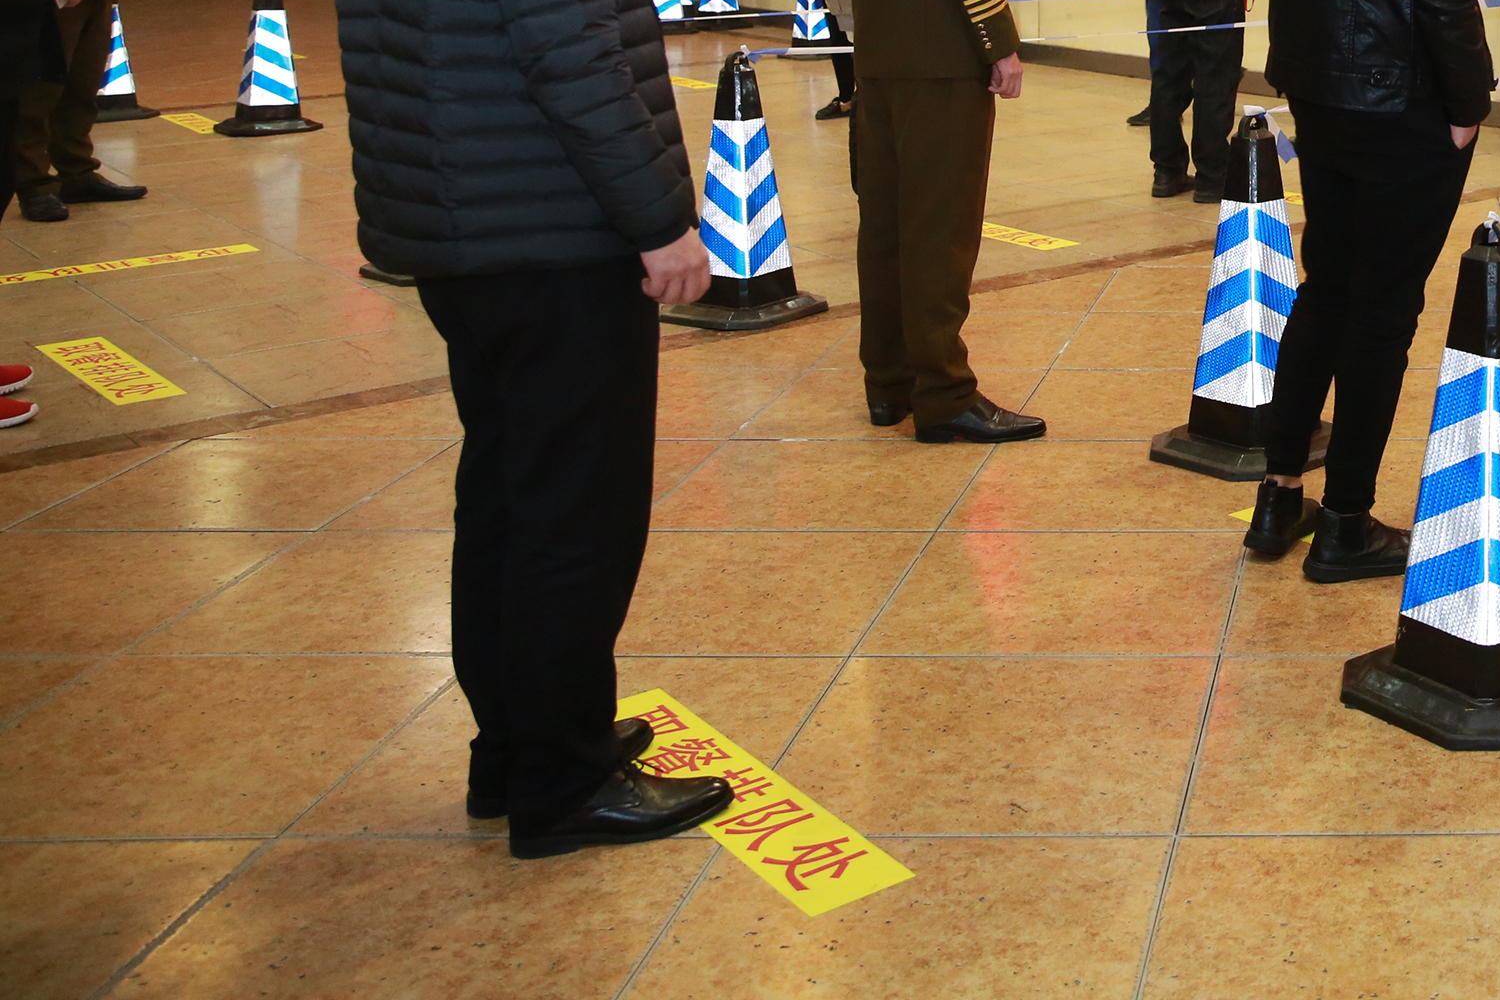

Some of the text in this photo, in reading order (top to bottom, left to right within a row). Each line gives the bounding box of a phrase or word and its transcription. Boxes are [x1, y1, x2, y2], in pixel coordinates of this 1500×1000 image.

[53, 341, 169, 399] 取餐排队处
